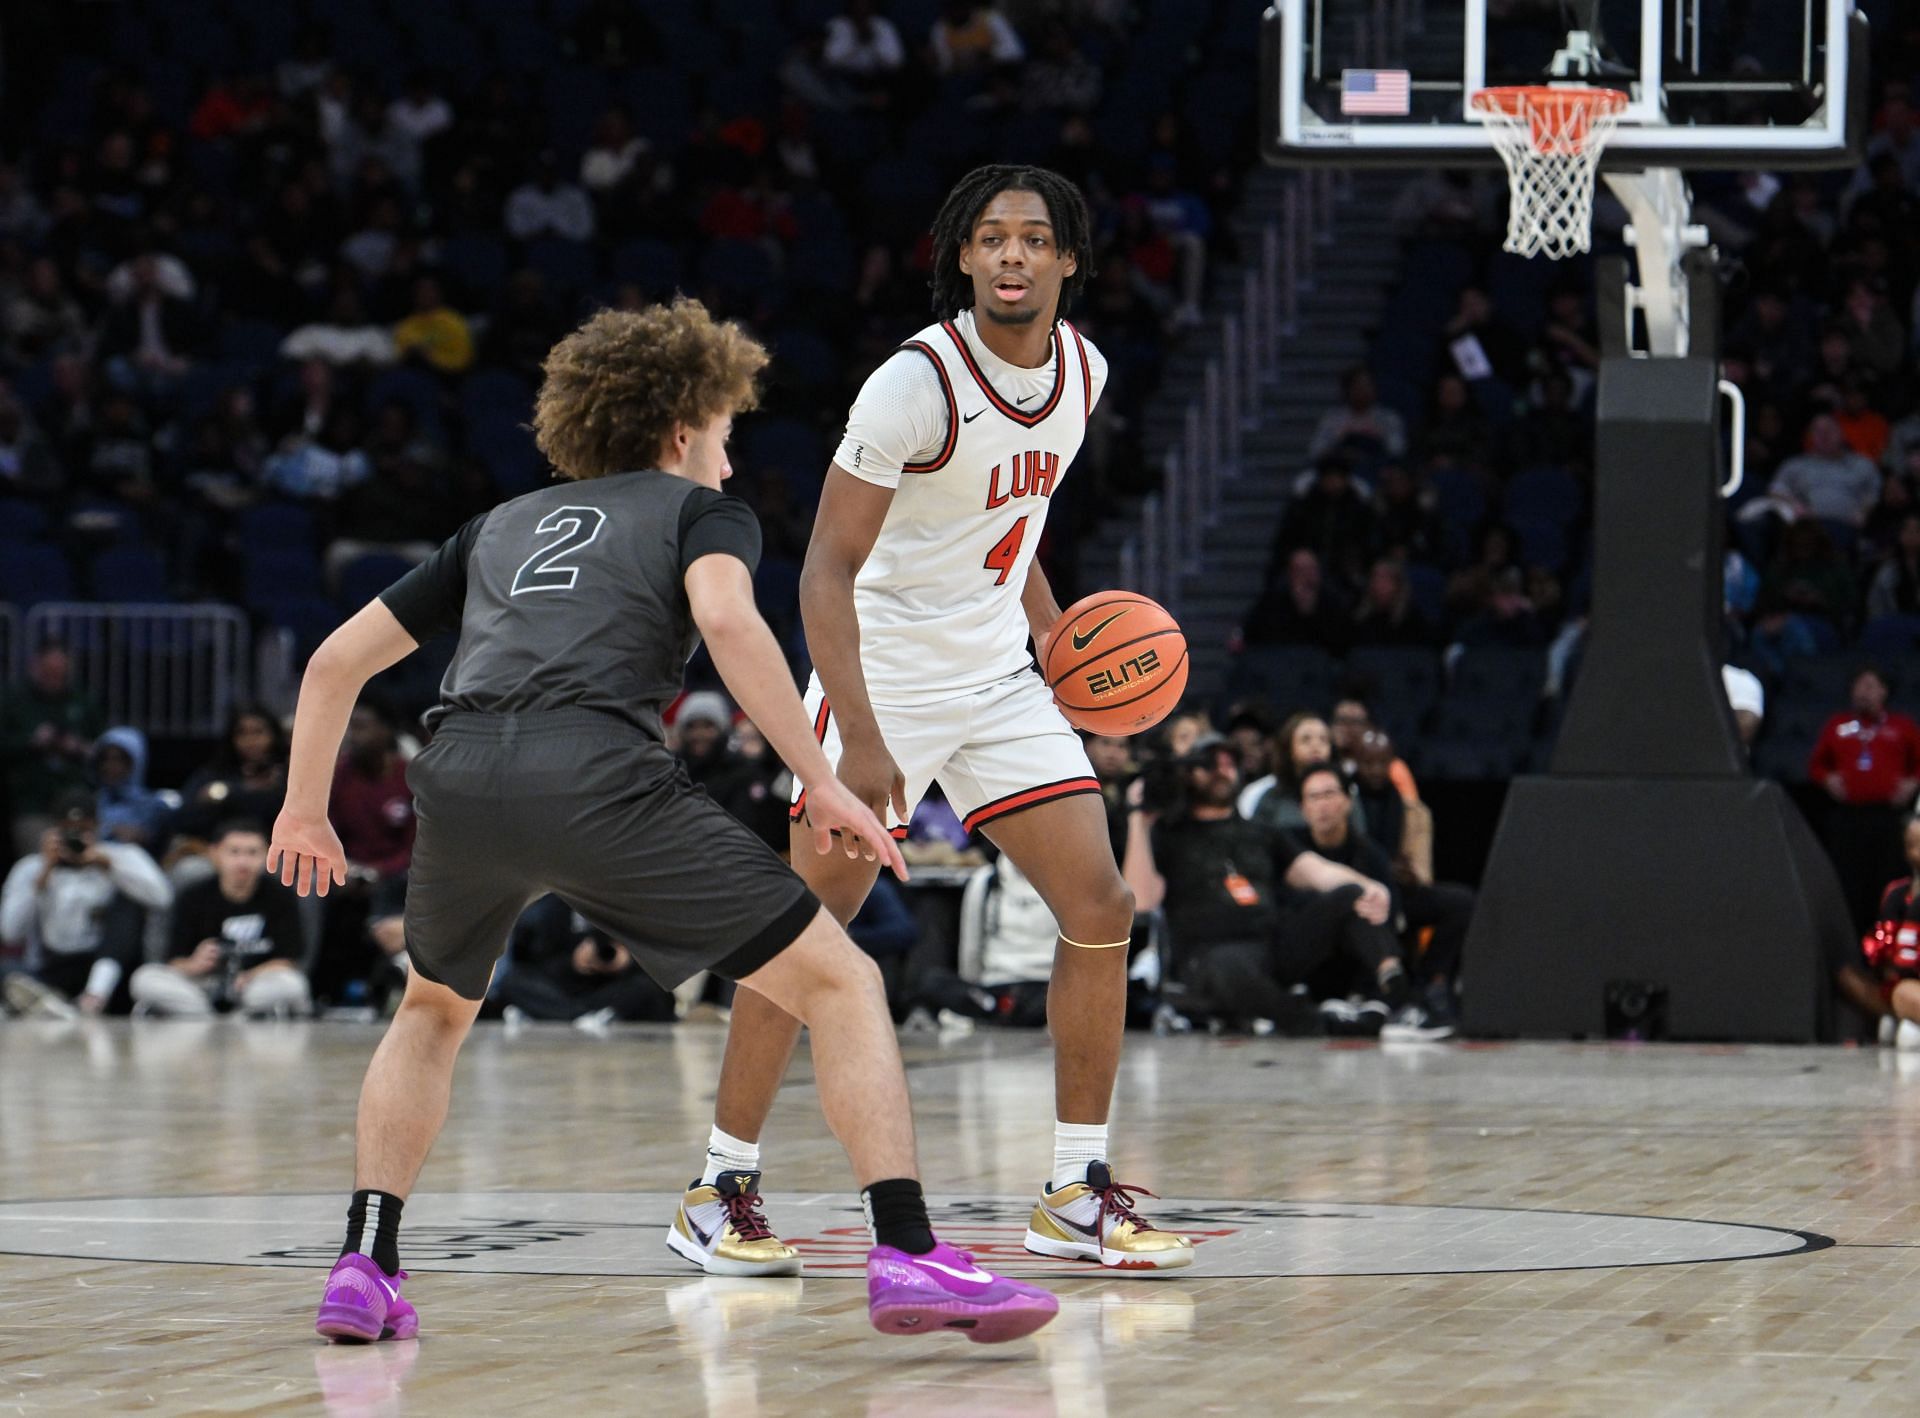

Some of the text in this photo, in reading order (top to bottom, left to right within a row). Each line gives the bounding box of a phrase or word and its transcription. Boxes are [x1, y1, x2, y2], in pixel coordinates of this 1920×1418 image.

[986, 450, 1060, 510] LUHI
[510, 505, 607, 597] 2
[983, 515, 1029, 586] 4
[1085, 648, 1161, 695] ELITE
